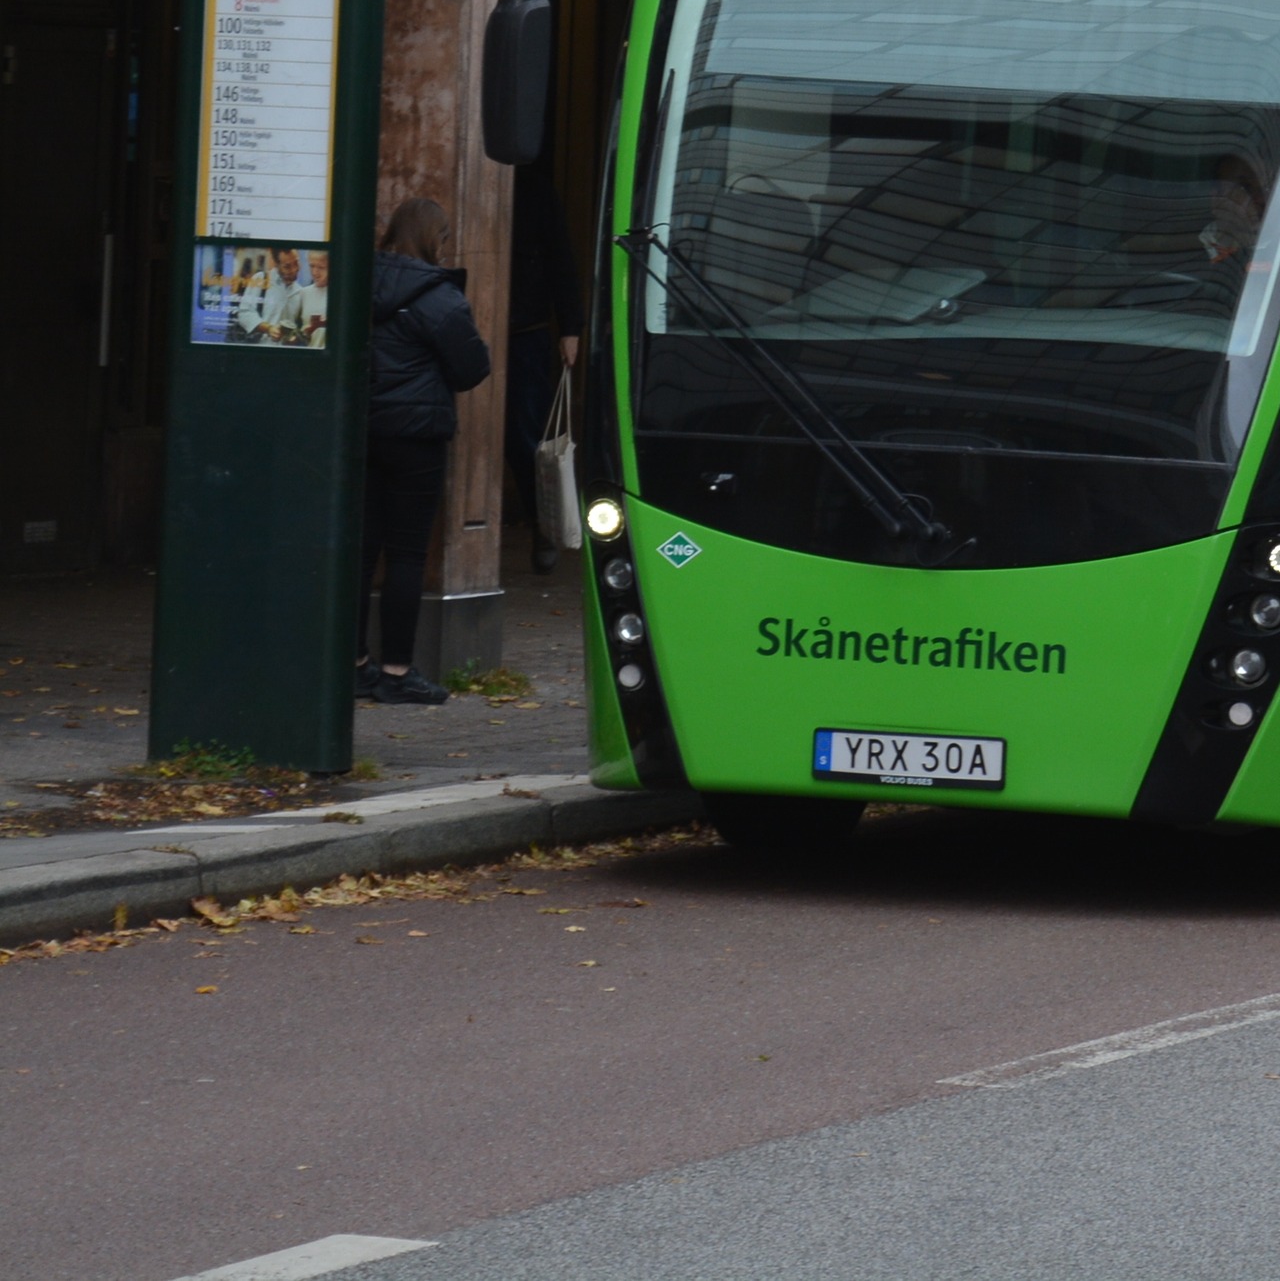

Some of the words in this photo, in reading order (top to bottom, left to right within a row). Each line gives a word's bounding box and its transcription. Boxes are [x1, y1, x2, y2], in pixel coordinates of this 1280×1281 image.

[218, 17, 242, 34] 100
[215, 85, 240, 103] 146
[214, 108, 239, 125] 148
[213, 130, 238, 147] 150
[212, 153, 236, 169] 151
[211, 175, 236, 192] 169
[210, 198, 234, 216] 171
[210, 221, 233, 237] 174
[663, 543, 695, 557] CNG
[755, 616, 1067, 675] Skånetrafiken
[819, 755, 828, 766] S
[845, 736, 909, 772] YRX
[921, 741, 988, 776] 30A
[880, 774, 906, 785] VOLVO
[906, 777, 934, 787] BUSES
